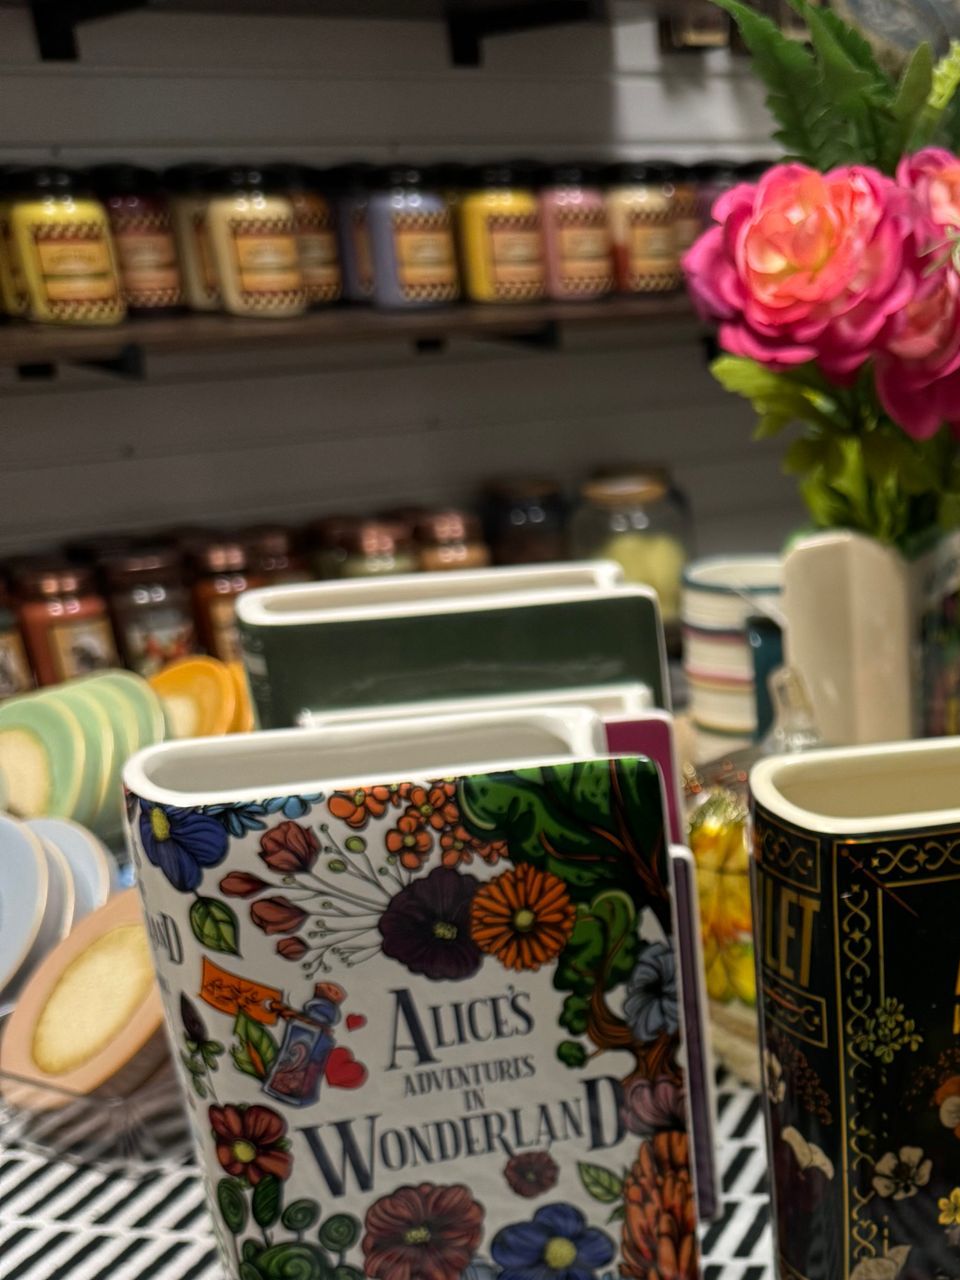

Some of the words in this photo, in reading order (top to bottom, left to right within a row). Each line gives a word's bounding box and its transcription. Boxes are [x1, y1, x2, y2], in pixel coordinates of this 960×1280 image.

[384, 984, 535, 1072] ALICE'S
[403, 1055, 536, 1098] ADVENTURES
[464, 1087, 486, 1112] IN
[296, 1075, 629, 1197] WONDERLAND
